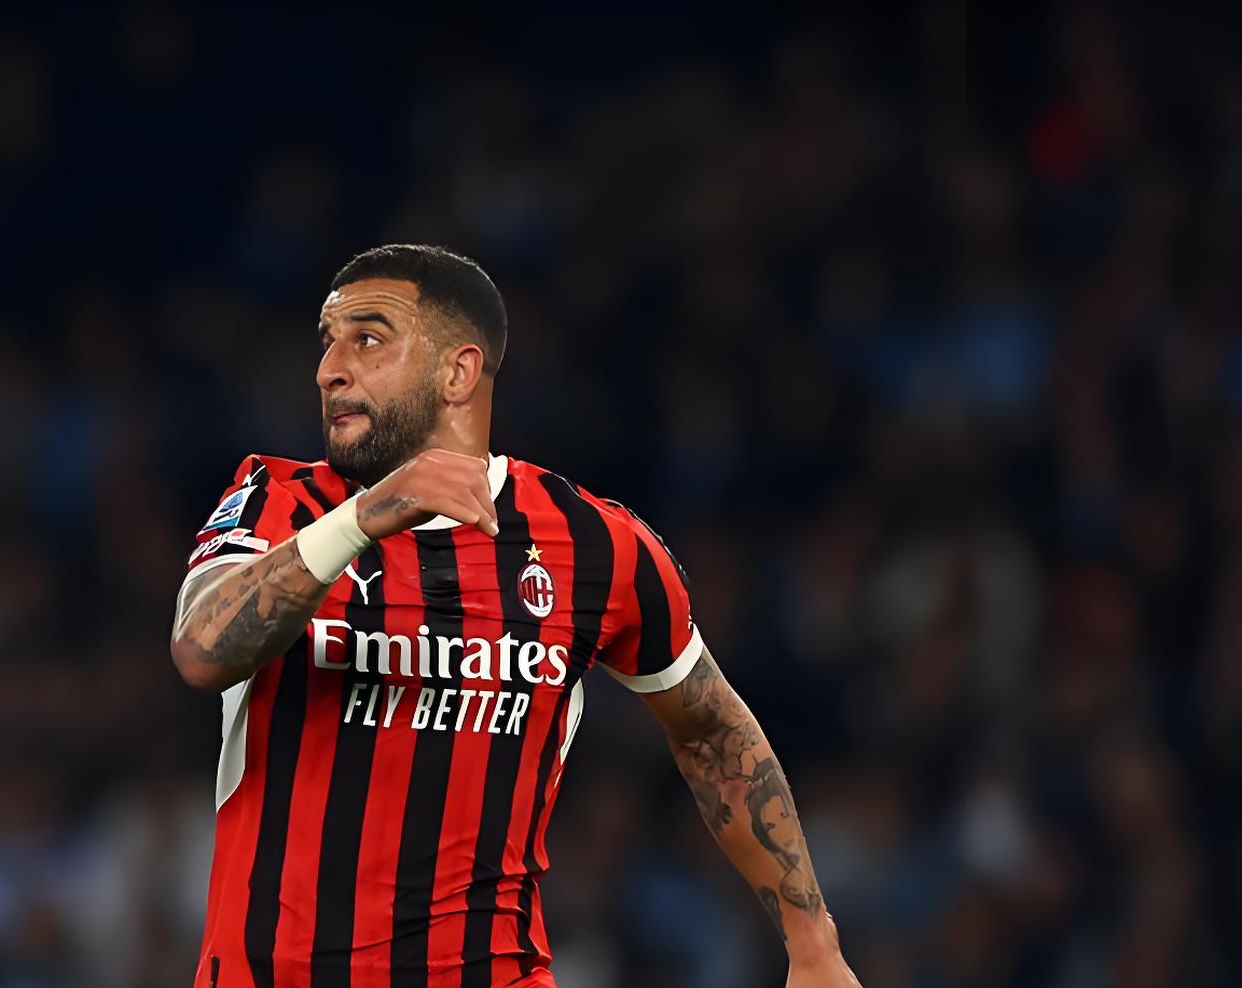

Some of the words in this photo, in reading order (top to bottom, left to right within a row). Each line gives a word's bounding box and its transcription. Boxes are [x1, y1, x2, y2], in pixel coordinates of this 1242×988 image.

[311, 617, 569, 687] Emirates
[343, 683, 406, 729] FLY
[411, 687, 530, 736] BETTER
